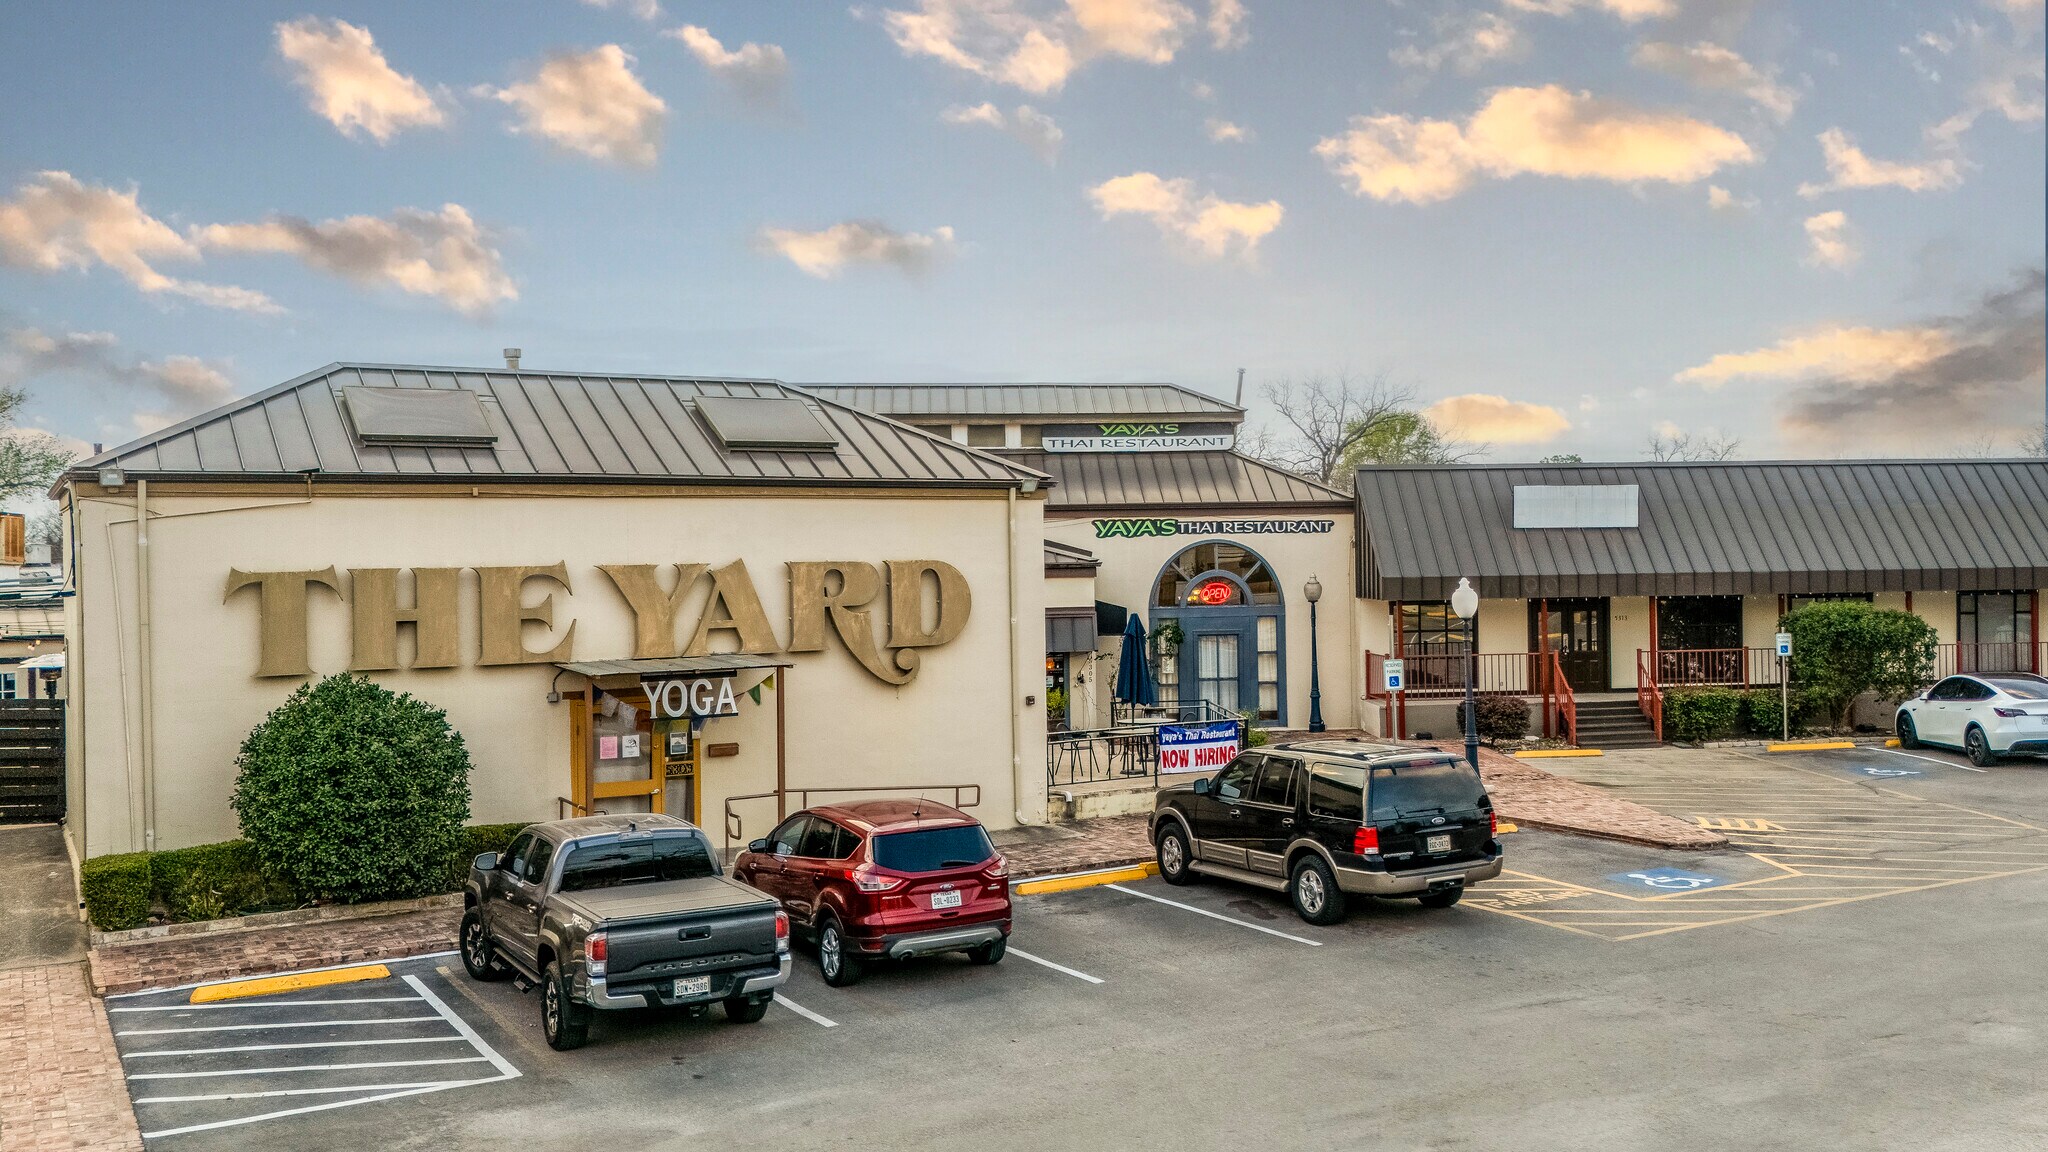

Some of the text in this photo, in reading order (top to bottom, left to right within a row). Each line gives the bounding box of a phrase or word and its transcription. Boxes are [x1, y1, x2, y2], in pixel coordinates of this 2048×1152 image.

[1099, 424, 1179, 436] YAYA'S
[1049, 437, 1228, 448] THAI RESTAURANT
[1094, 520, 1333, 537] YAYA'S THAI RESTAURANT
[1202, 587, 1228, 599] OPEN
[223, 557, 972, 686] THE YARD
[641, 677, 739, 719] YOGA
[1185, 731, 1200, 740] Thai
[1201, 727, 1235, 740] Restaurant
[1161, 745, 1236, 769] NOW HIRING
[646, 955, 743, 972] TACOMA
